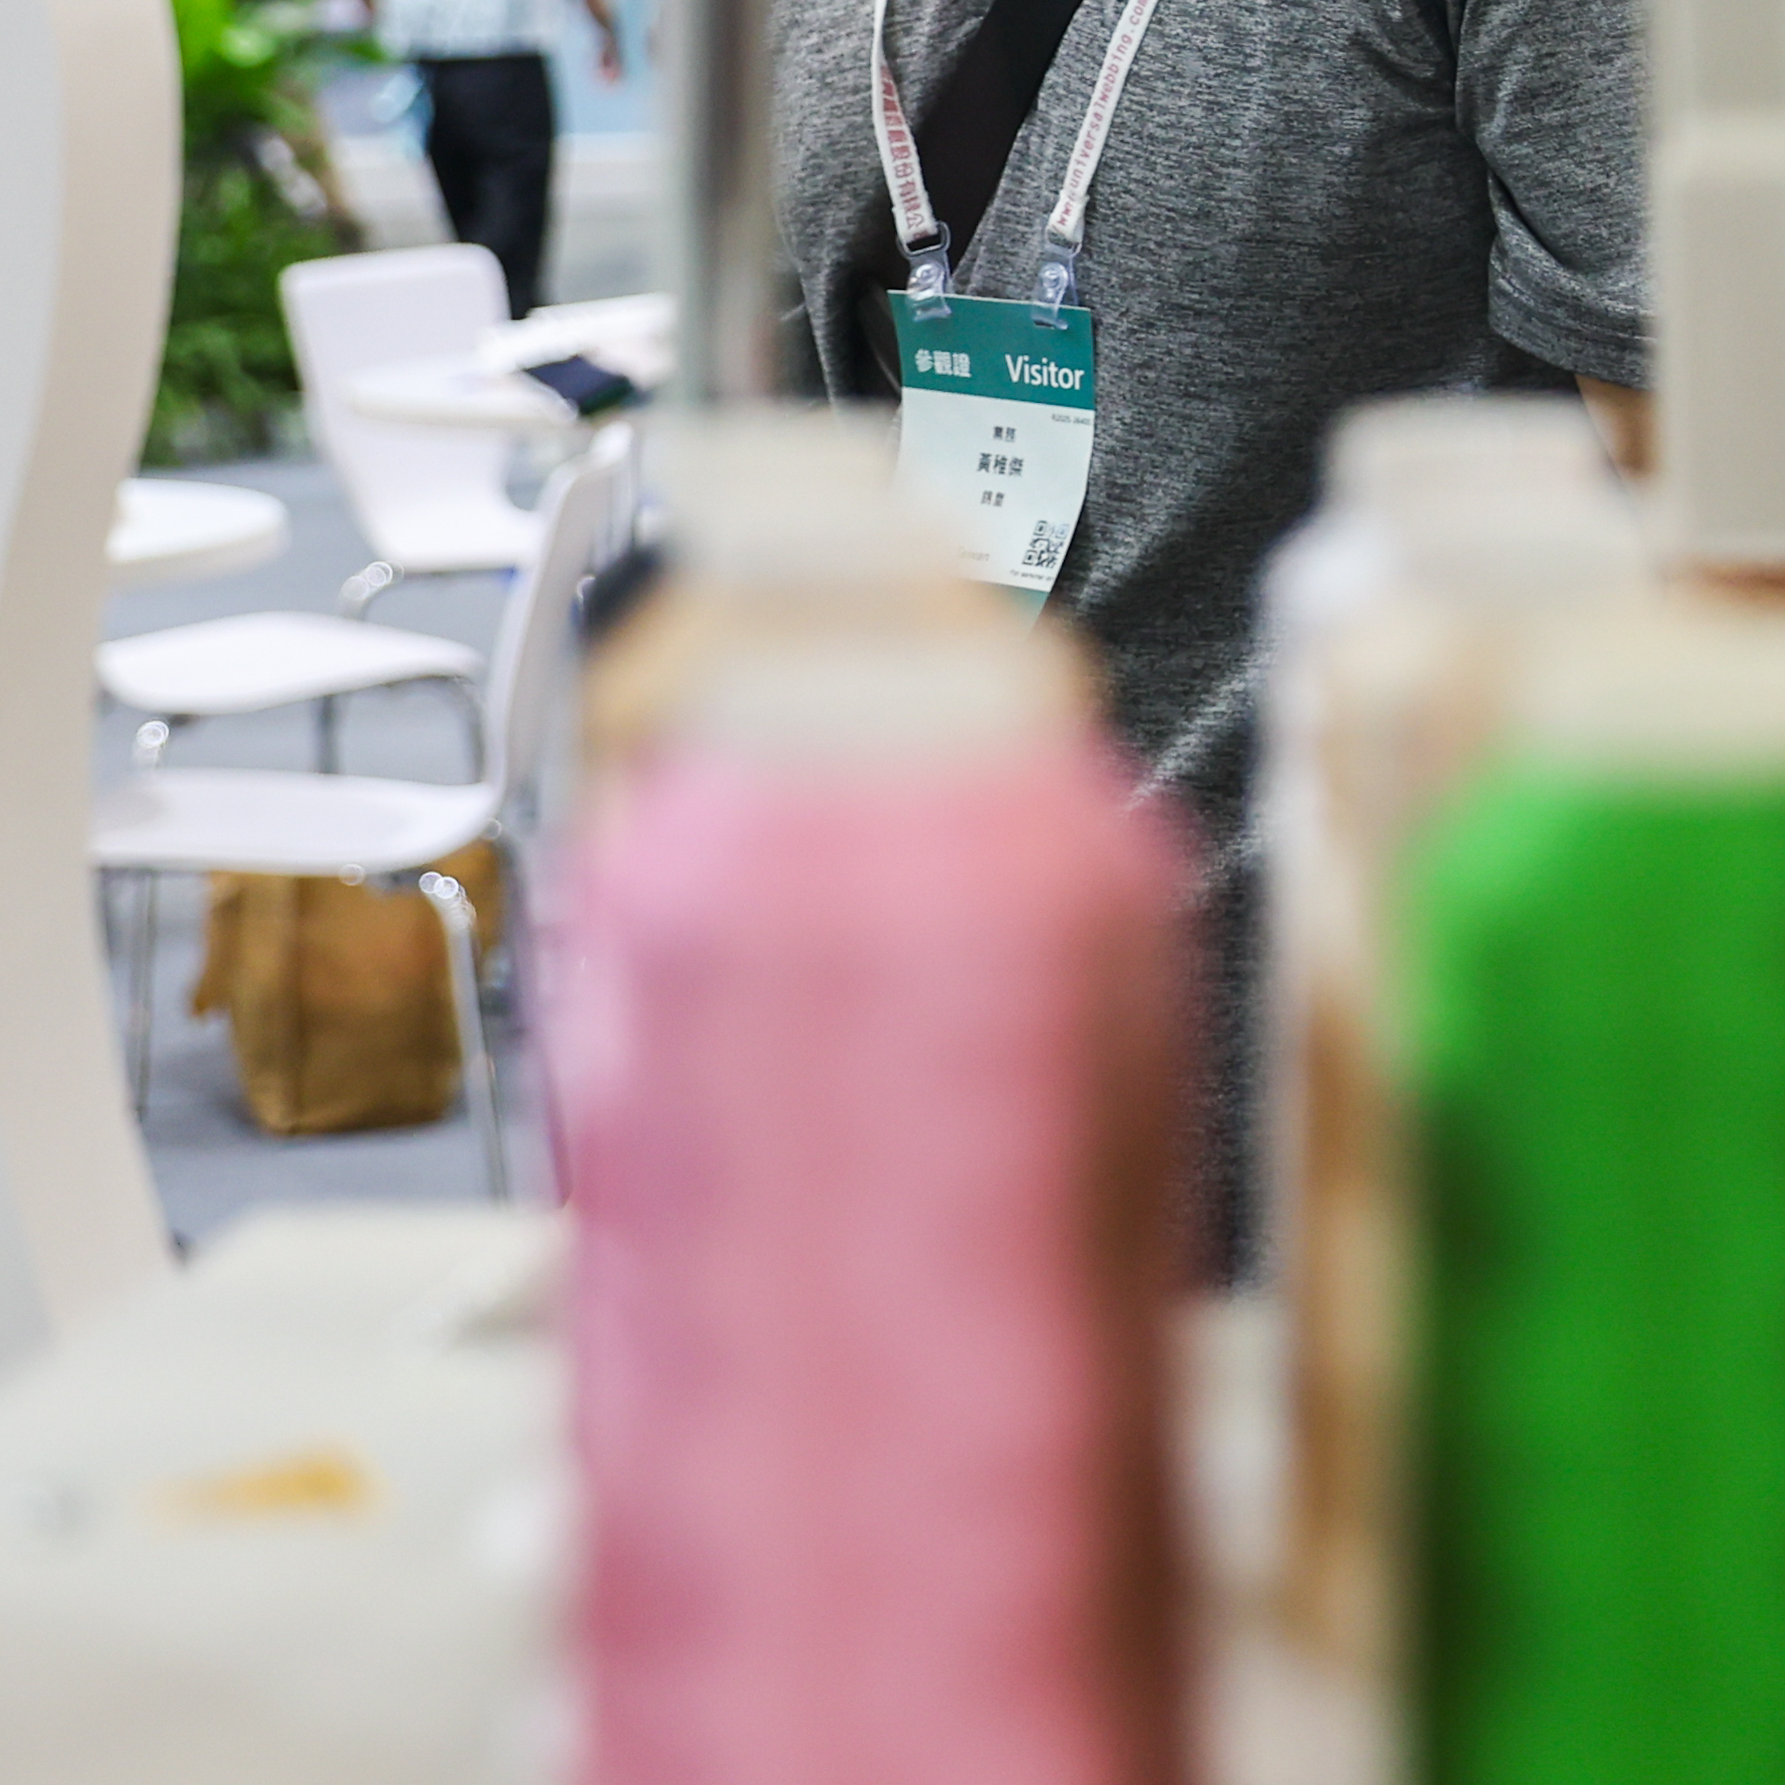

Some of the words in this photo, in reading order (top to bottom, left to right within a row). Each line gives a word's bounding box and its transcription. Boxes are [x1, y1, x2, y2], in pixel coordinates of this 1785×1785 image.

[914, 348, 972, 378] 參觀證
[1004, 353, 1085, 391] Visitor
